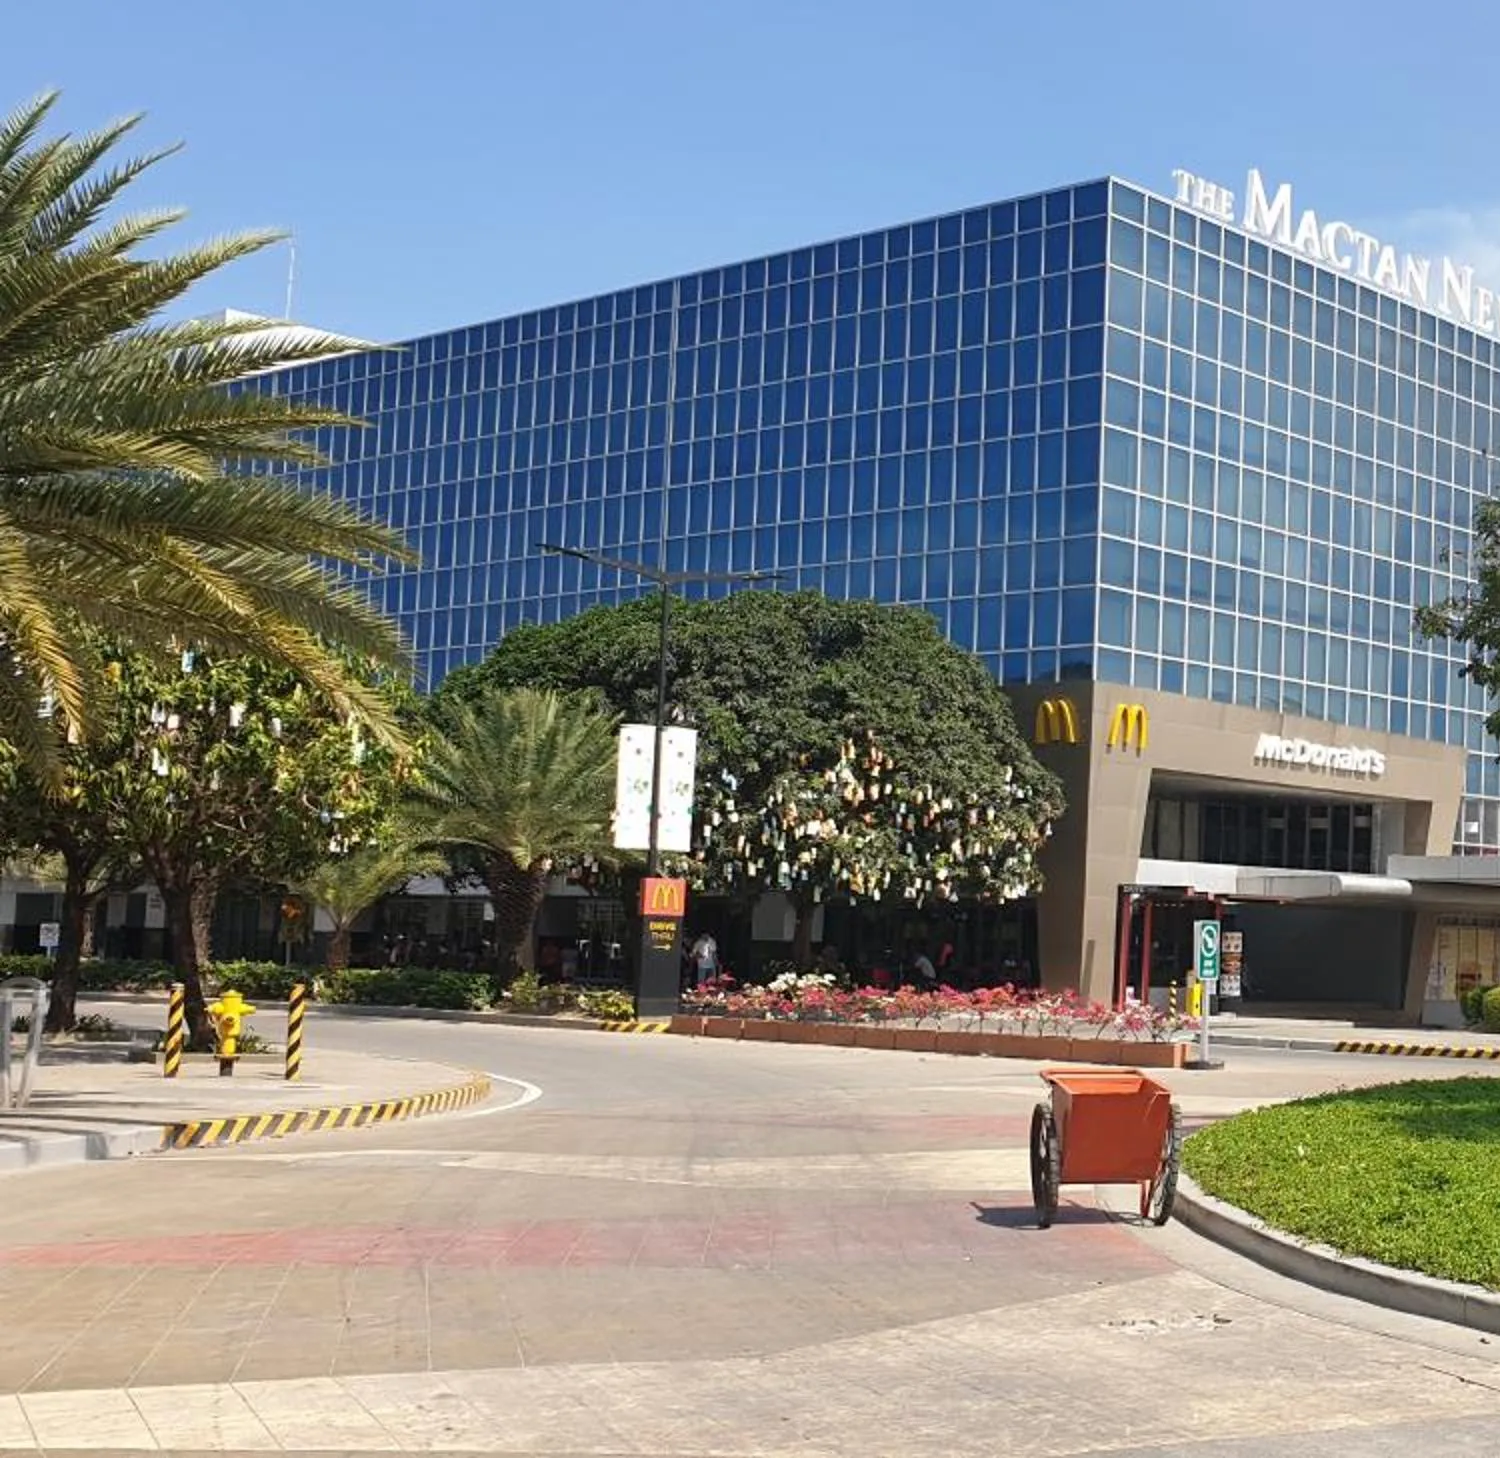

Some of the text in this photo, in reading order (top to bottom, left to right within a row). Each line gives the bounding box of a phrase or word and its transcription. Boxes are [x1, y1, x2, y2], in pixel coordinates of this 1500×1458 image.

[1171, 168, 1234, 221] THE
[1242, 168, 1430, 307] MACTAN
[1253, 732, 1386, 775] McDonald's
